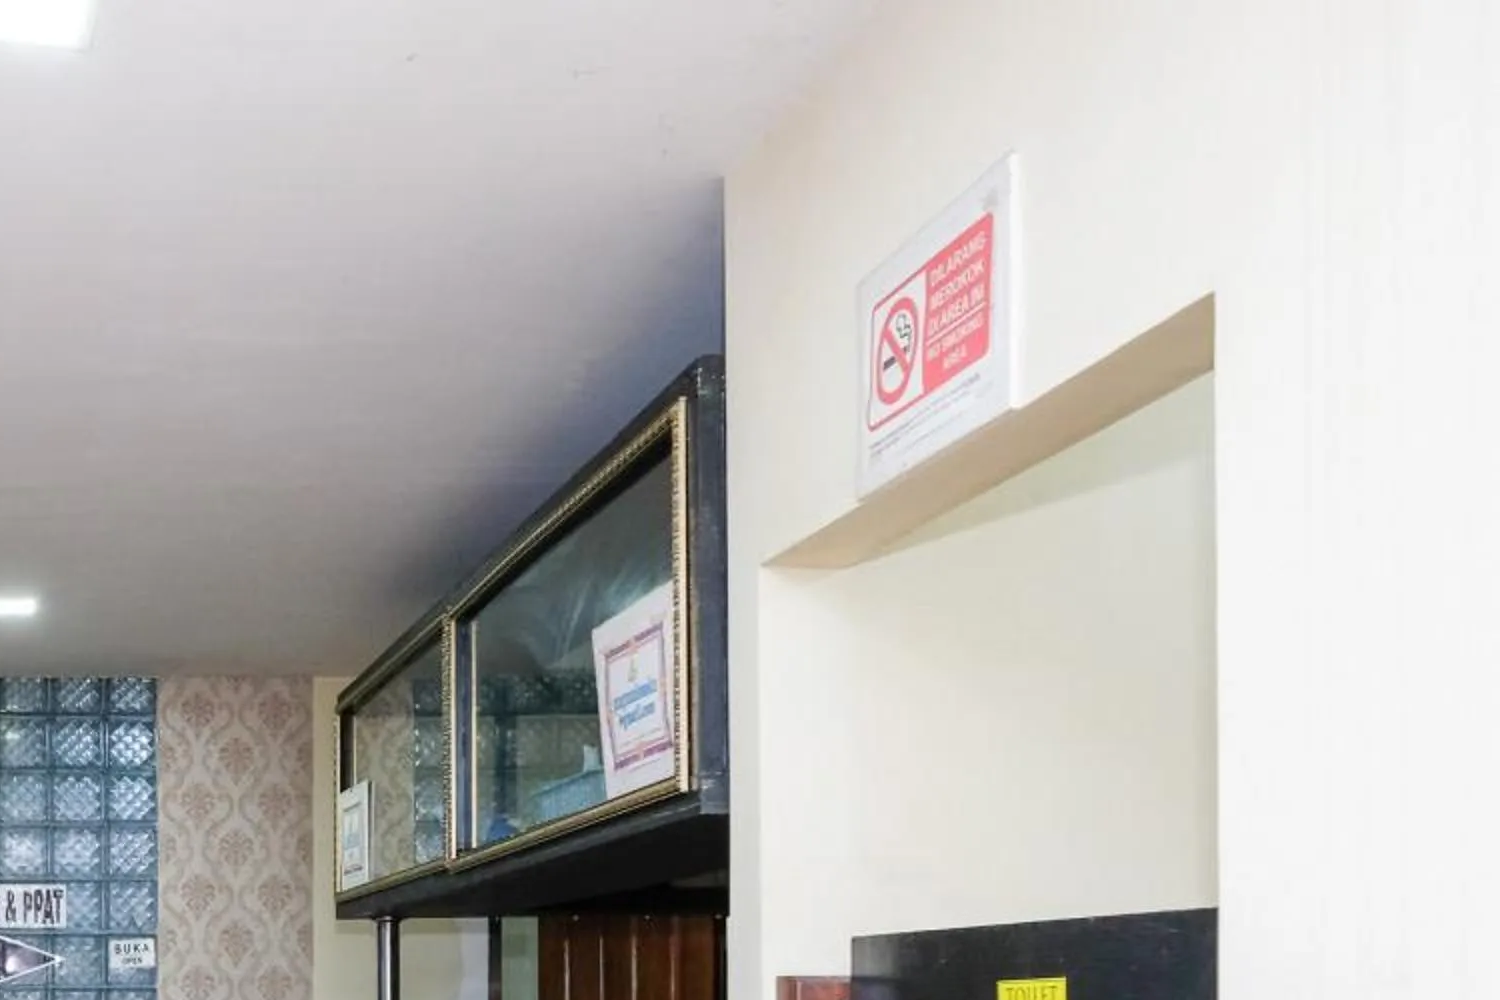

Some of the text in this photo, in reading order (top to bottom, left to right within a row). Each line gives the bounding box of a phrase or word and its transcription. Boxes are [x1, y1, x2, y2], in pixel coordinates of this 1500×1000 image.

[5, 889, 17, 923] &
[23, 889, 64, 924] PPAT
[114, 943, 149, 954] BUKA
